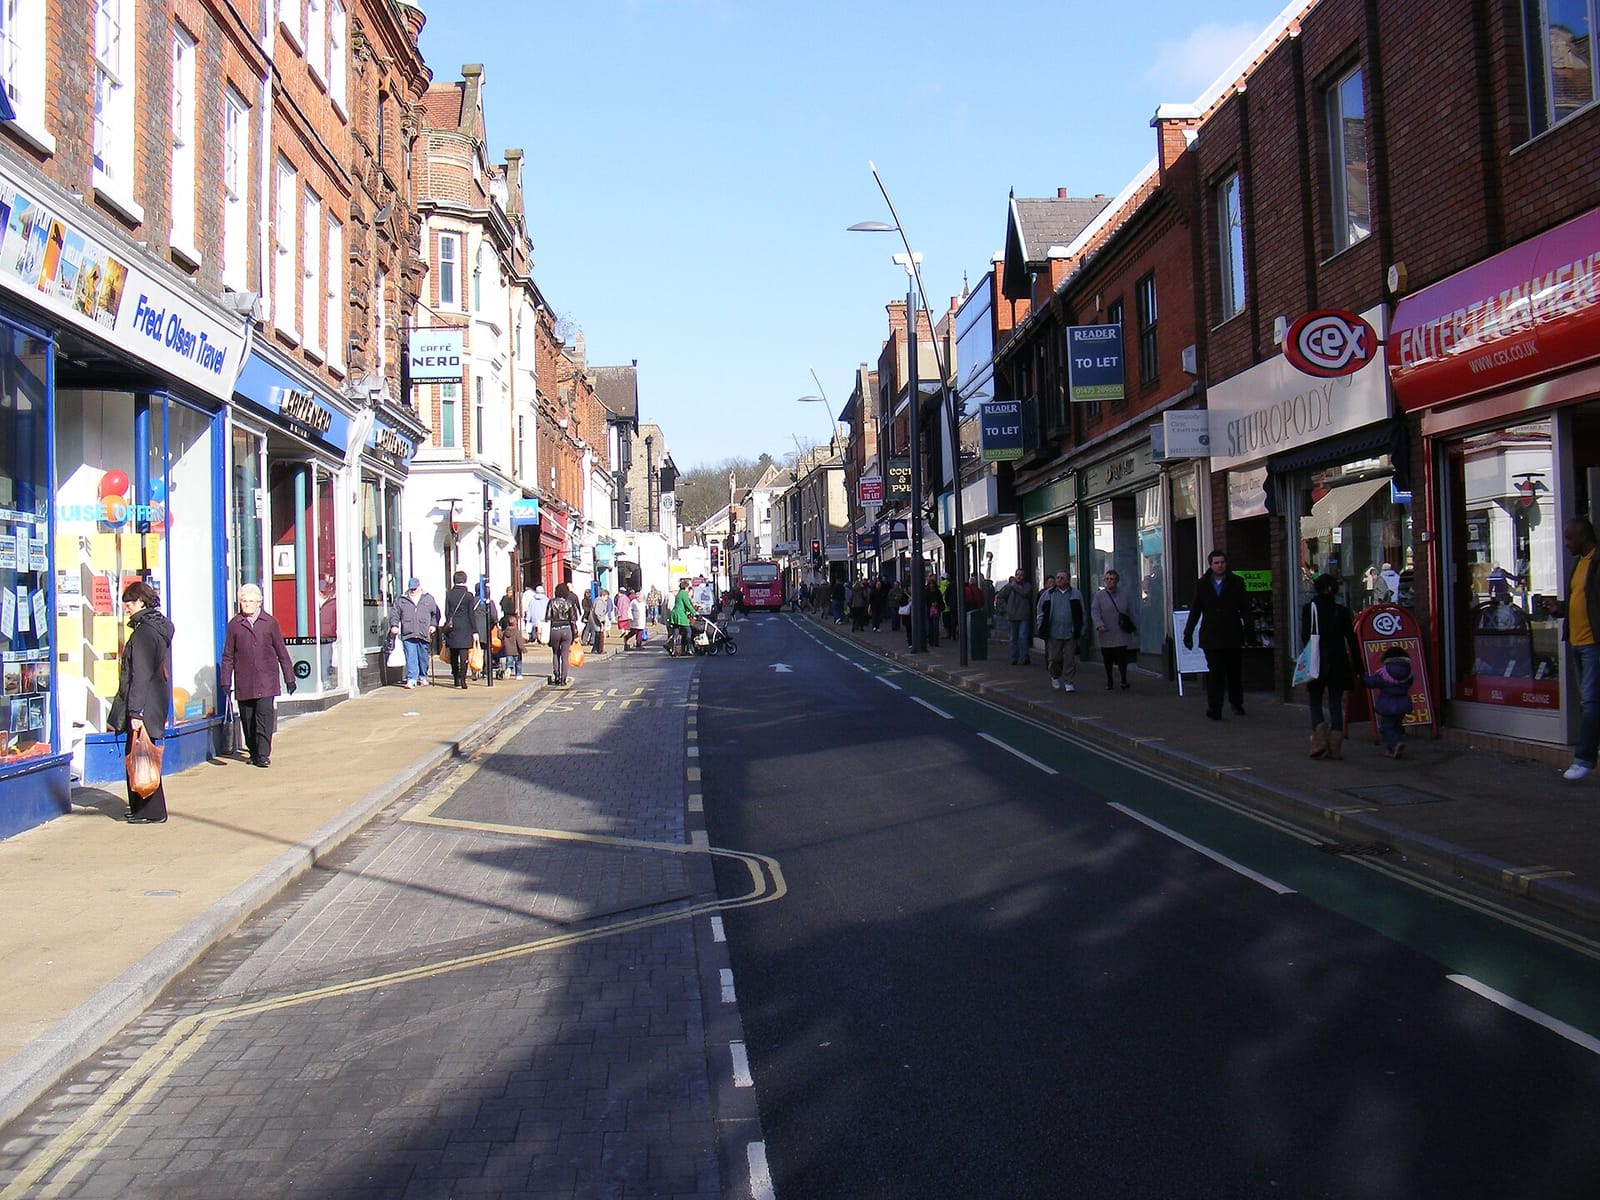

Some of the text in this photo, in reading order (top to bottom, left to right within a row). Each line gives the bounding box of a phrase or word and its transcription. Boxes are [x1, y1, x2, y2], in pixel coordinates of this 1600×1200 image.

[1074, 328, 1117, 341] READER
[165, 313, 197, 360] Olsen
[196, 331, 228, 375] Travel
[412, 356, 460, 367] NERO
[1075, 356, 1118, 369] TO LET
[1467, 340, 1539, 374] WWW.CEX.CO.UK
[984, 404, 1018, 414] READER
[1227, 382, 1334, 458] SHUROPODY
[985, 426, 1019, 436] TO LET
[898, 475, 906, 483] &
[1368, 642, 1387, 653] WE
